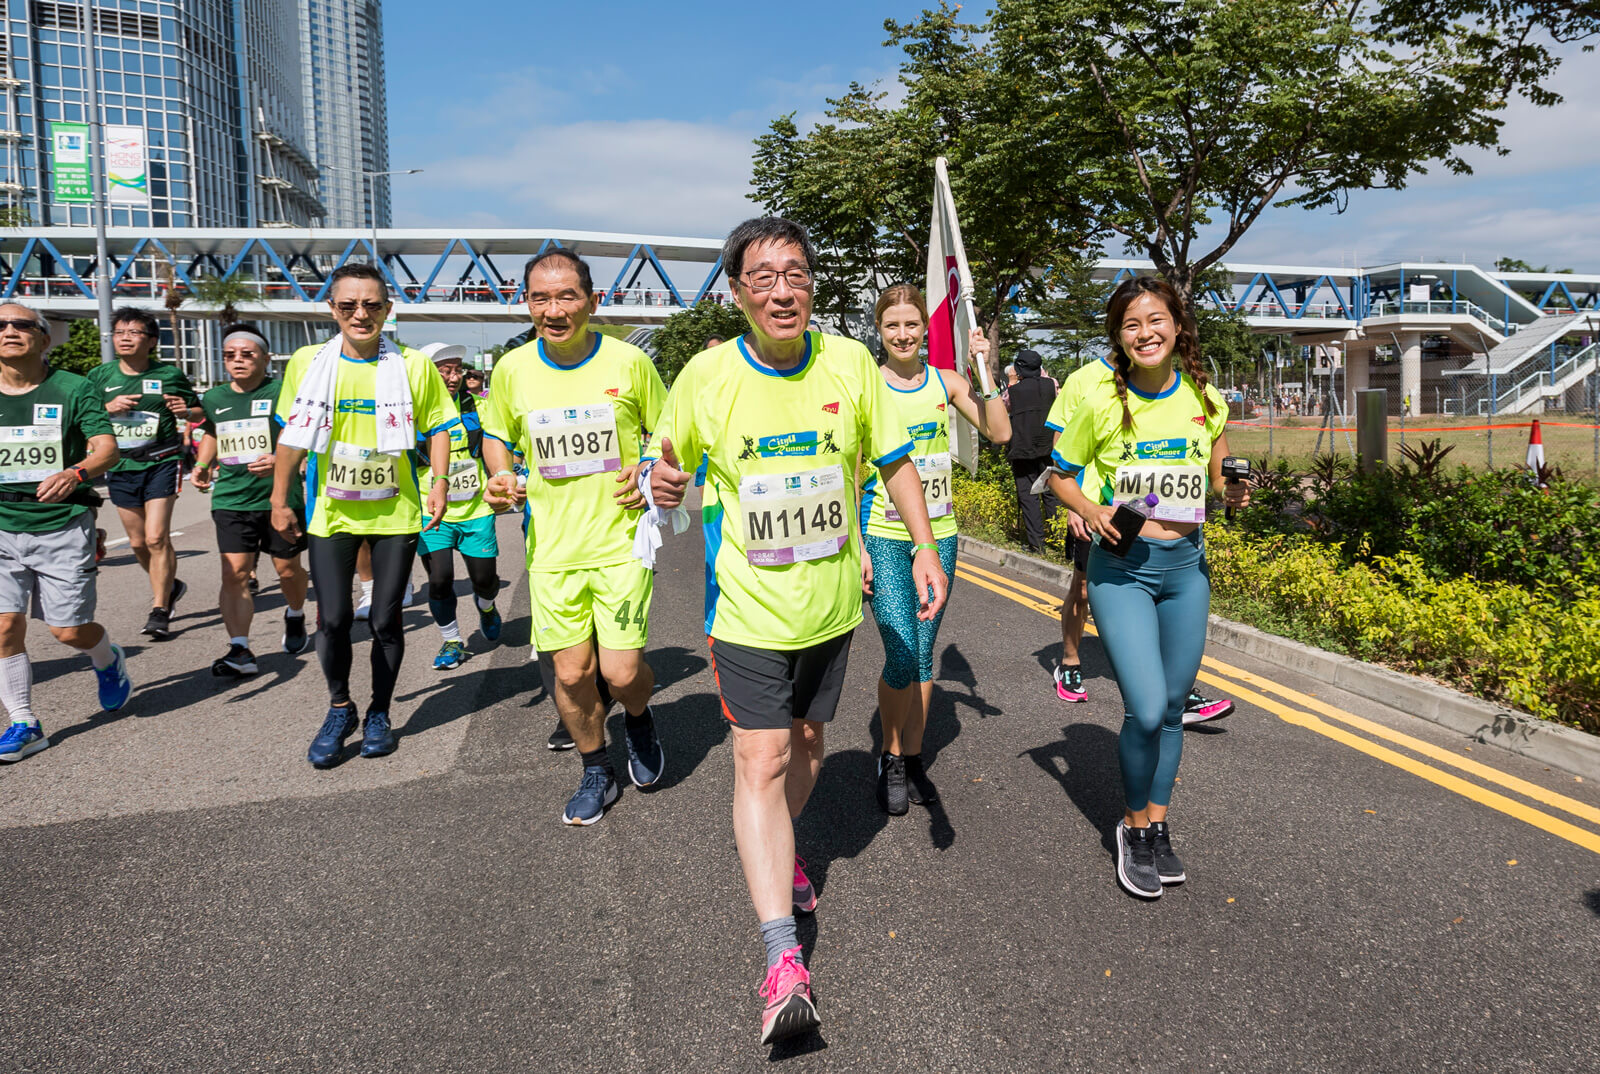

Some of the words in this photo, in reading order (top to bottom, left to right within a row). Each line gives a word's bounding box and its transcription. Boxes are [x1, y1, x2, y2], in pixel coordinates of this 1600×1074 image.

[110, 159, 142, 167] KONG
[57, 187, 89, 195] 24.10
[113, 424, 153, 437] 2108
[220, 434, 268, 453] M1109
[535, 429, 613, 459] M1987
[767, 434, 797, 451] CityU
[774, 446, 811, 456] Runner
[1143, 440, 1169, 454] CityU
[0, 446, 57, 467] 2499
[1150, 450, 1181, 458] Runner
[330, 463, 395, 486] M1961
[1119, 471, 1202, 500] M1658
[748, 500, 843, 540] M1148
[614, 600, 644, 631] 44
